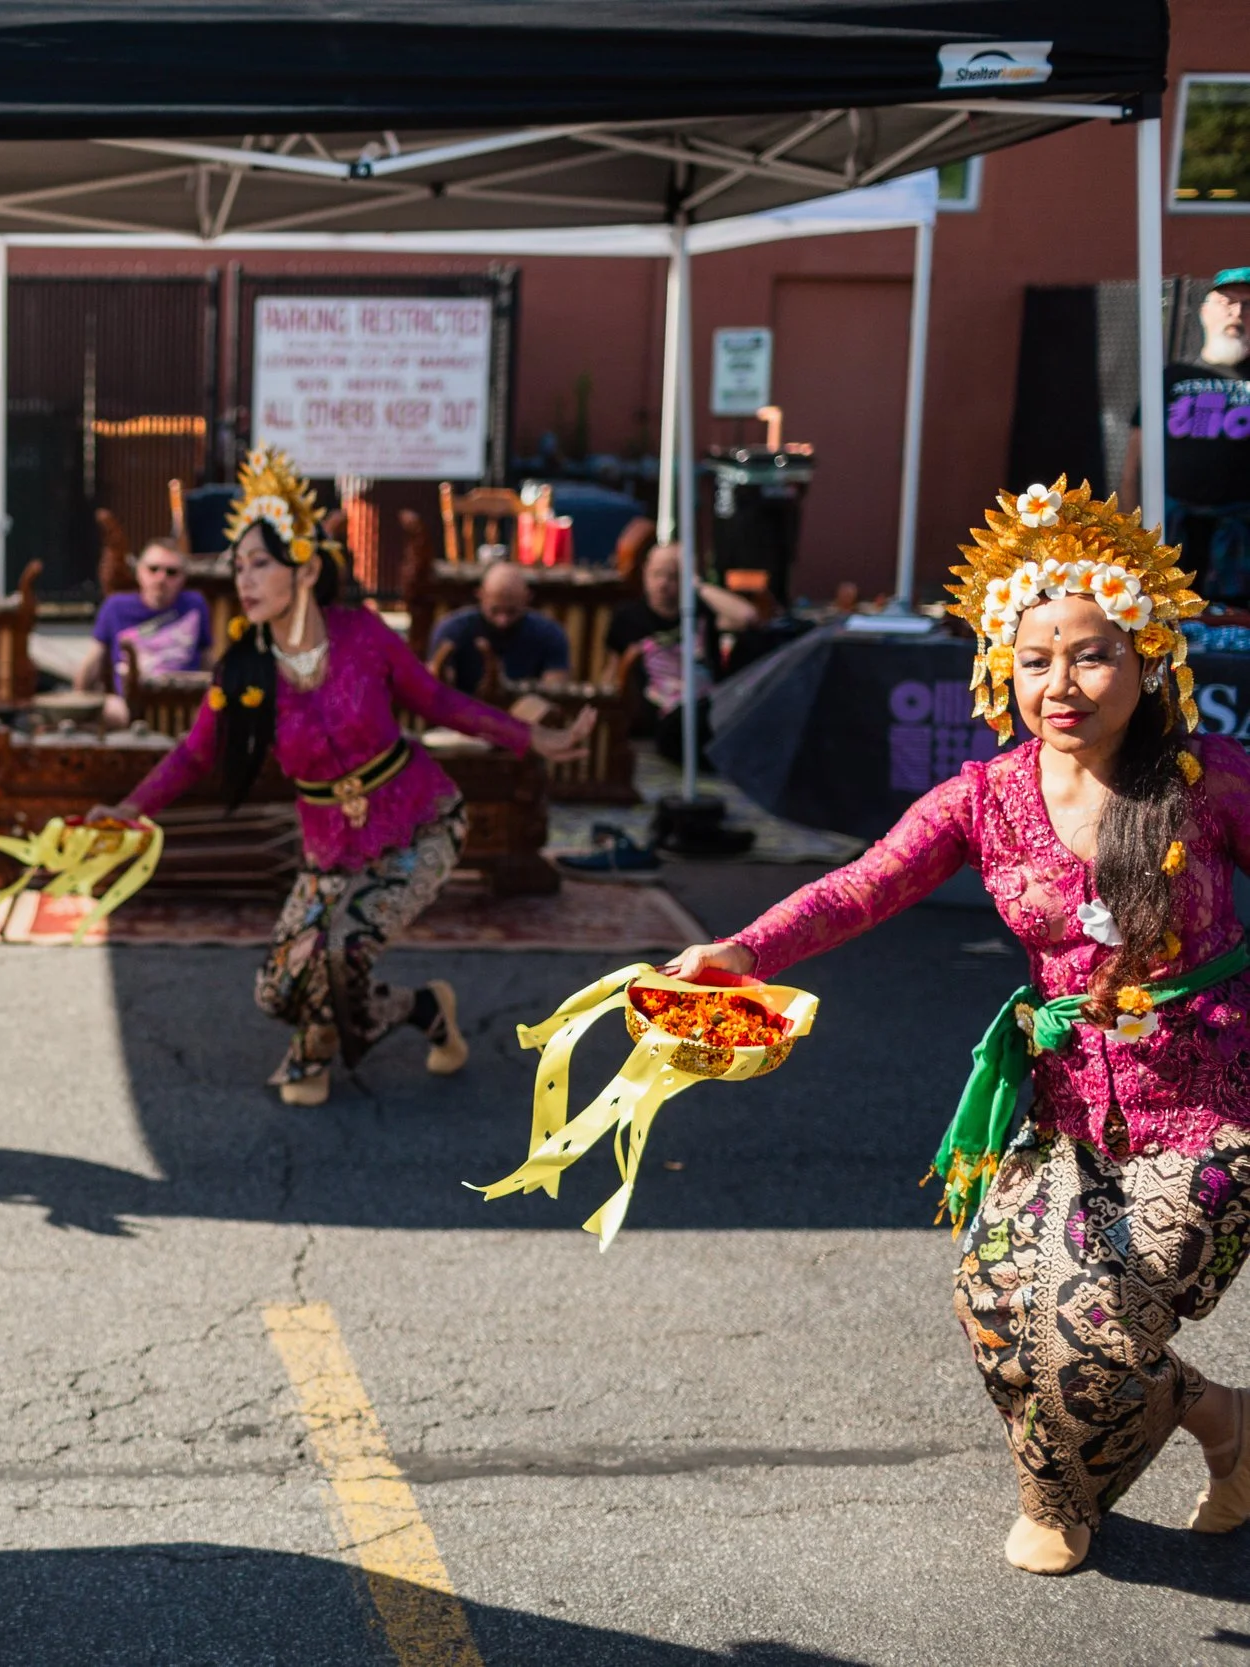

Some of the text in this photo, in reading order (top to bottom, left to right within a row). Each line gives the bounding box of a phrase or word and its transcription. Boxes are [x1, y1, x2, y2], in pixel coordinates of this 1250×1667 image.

[264, 307, 482, 337] PARKING RESTRICTED
[264, 401, 480, 430] ALL OTHERS KEEP OUT
